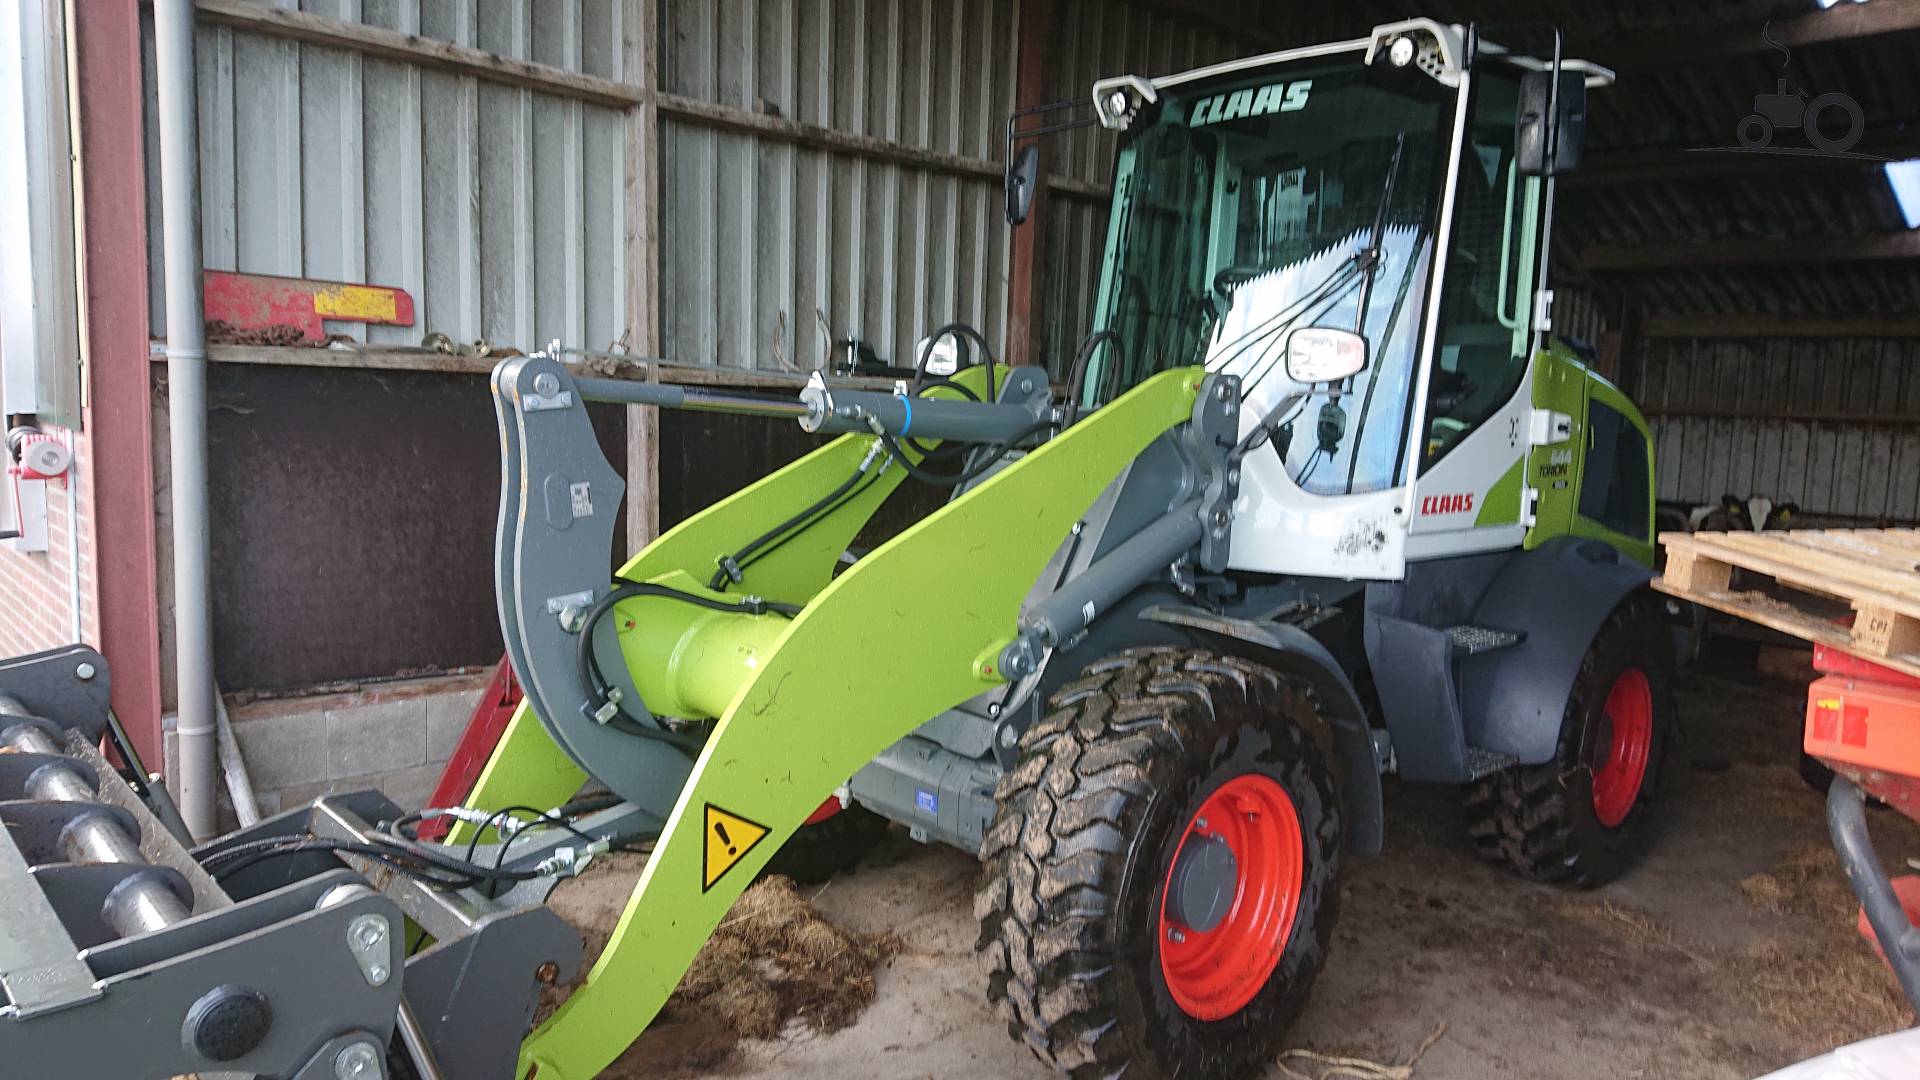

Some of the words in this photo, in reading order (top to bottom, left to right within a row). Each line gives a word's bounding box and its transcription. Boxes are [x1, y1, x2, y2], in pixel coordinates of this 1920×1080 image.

[1190, 80, 1312, 128] CLAAS
[1540, 464, 1568, 478] TORION
[1422, 493, 1473, 515] CLAAS
